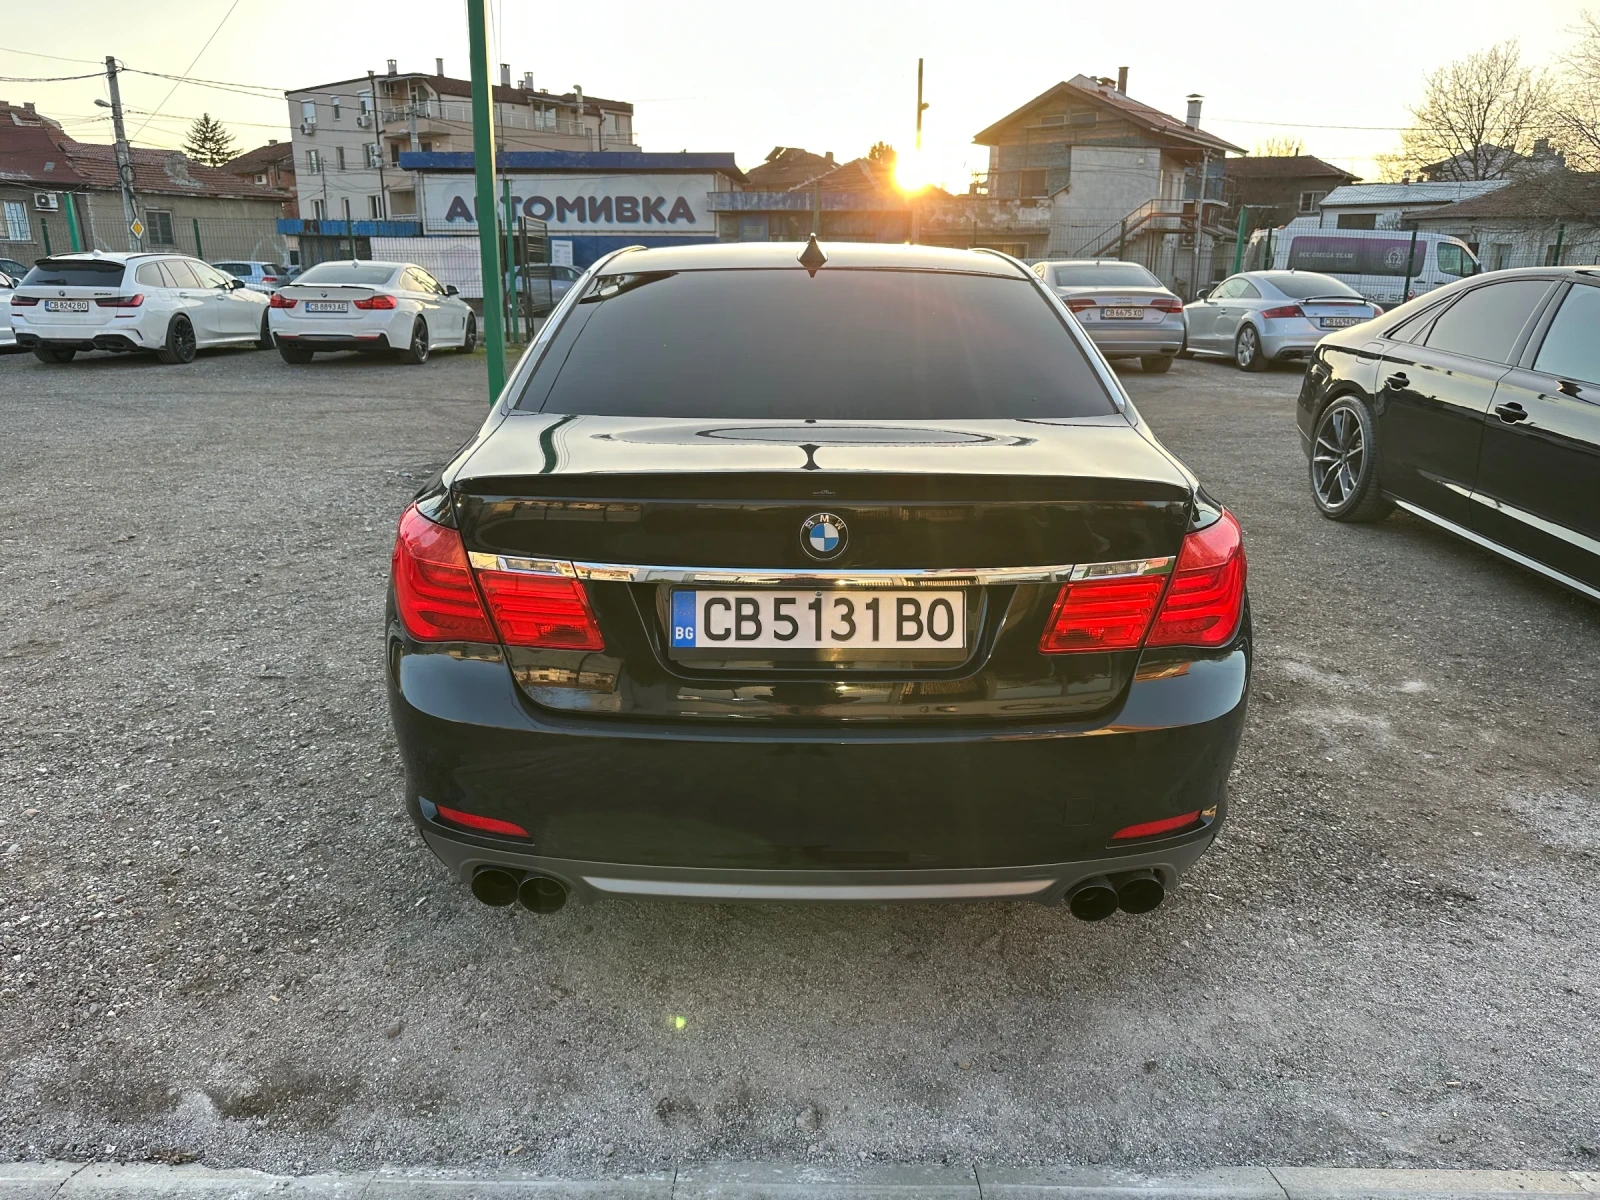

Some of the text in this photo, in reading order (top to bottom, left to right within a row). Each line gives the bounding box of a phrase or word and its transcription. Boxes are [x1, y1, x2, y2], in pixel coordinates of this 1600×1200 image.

[445, 195, 696, 224] АТОМИВКА
[59, 301, 76, 309] 8242
[1116, 309, 1132, 317] 6675
[1335, 318, 1350, 326] 6694
[804, 514, 845, 531] BMW
[703, 597, 763, 641] CB
[773, 596, 880, 642] 5131
[675, 626, 694, 640] BG
